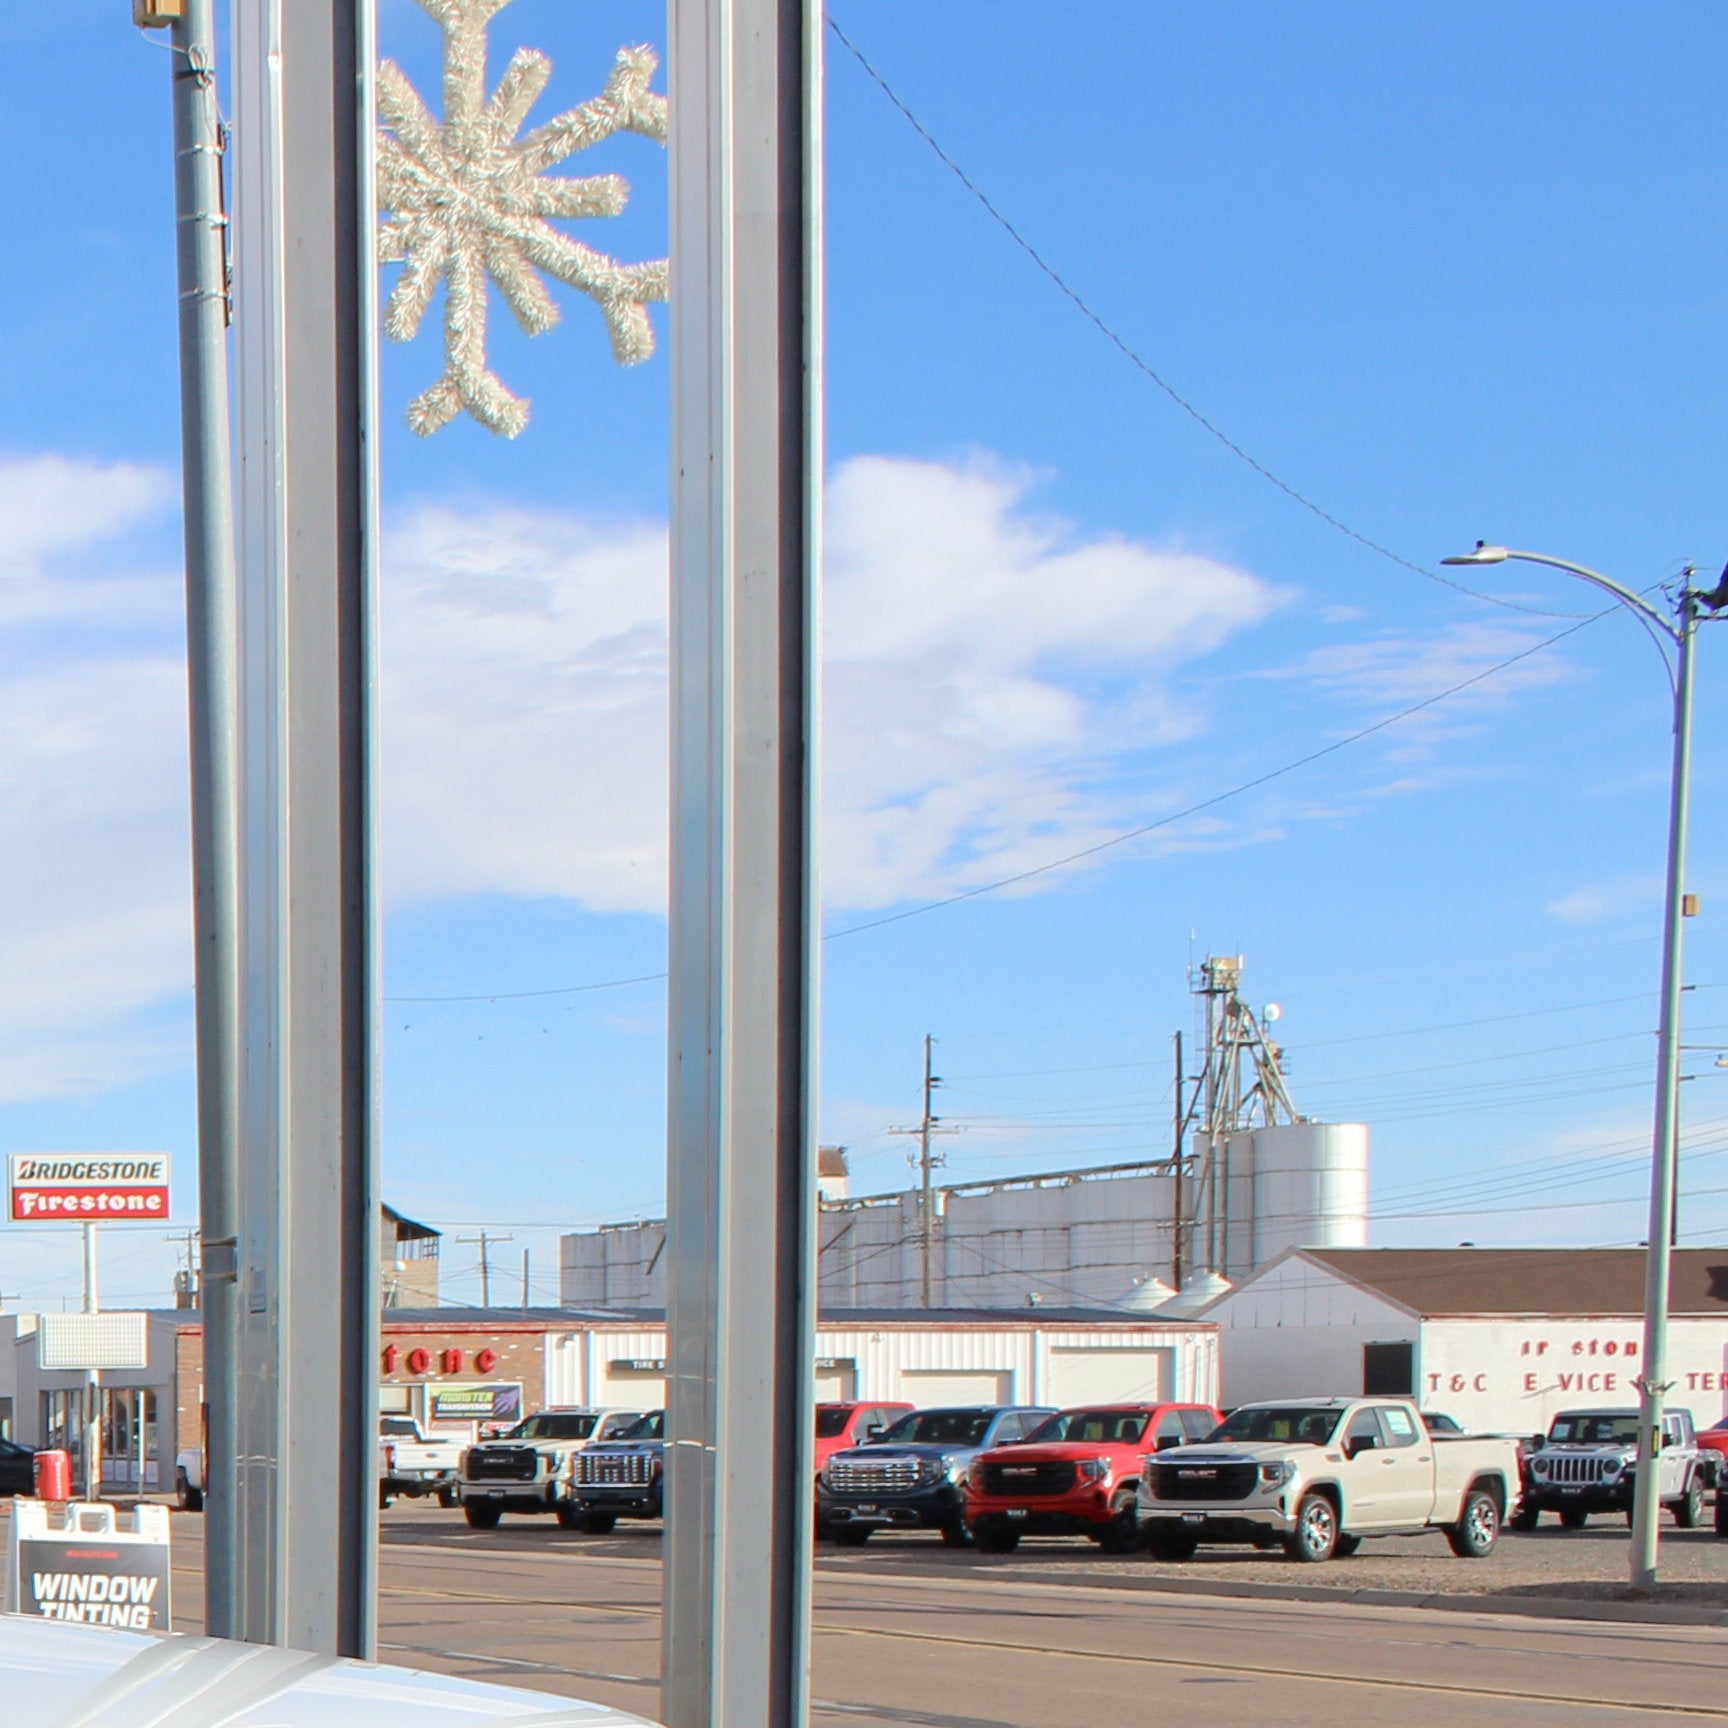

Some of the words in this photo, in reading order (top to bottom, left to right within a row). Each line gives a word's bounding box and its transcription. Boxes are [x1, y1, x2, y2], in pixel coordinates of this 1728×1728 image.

[18, 1161, 163, 1180] BRIDGESTONE
[18, 1192, 162, 1216] Firestone
[34, 1573, 158, 1604] WINDOW
[40, 1602, 152, 1629] TINTING
